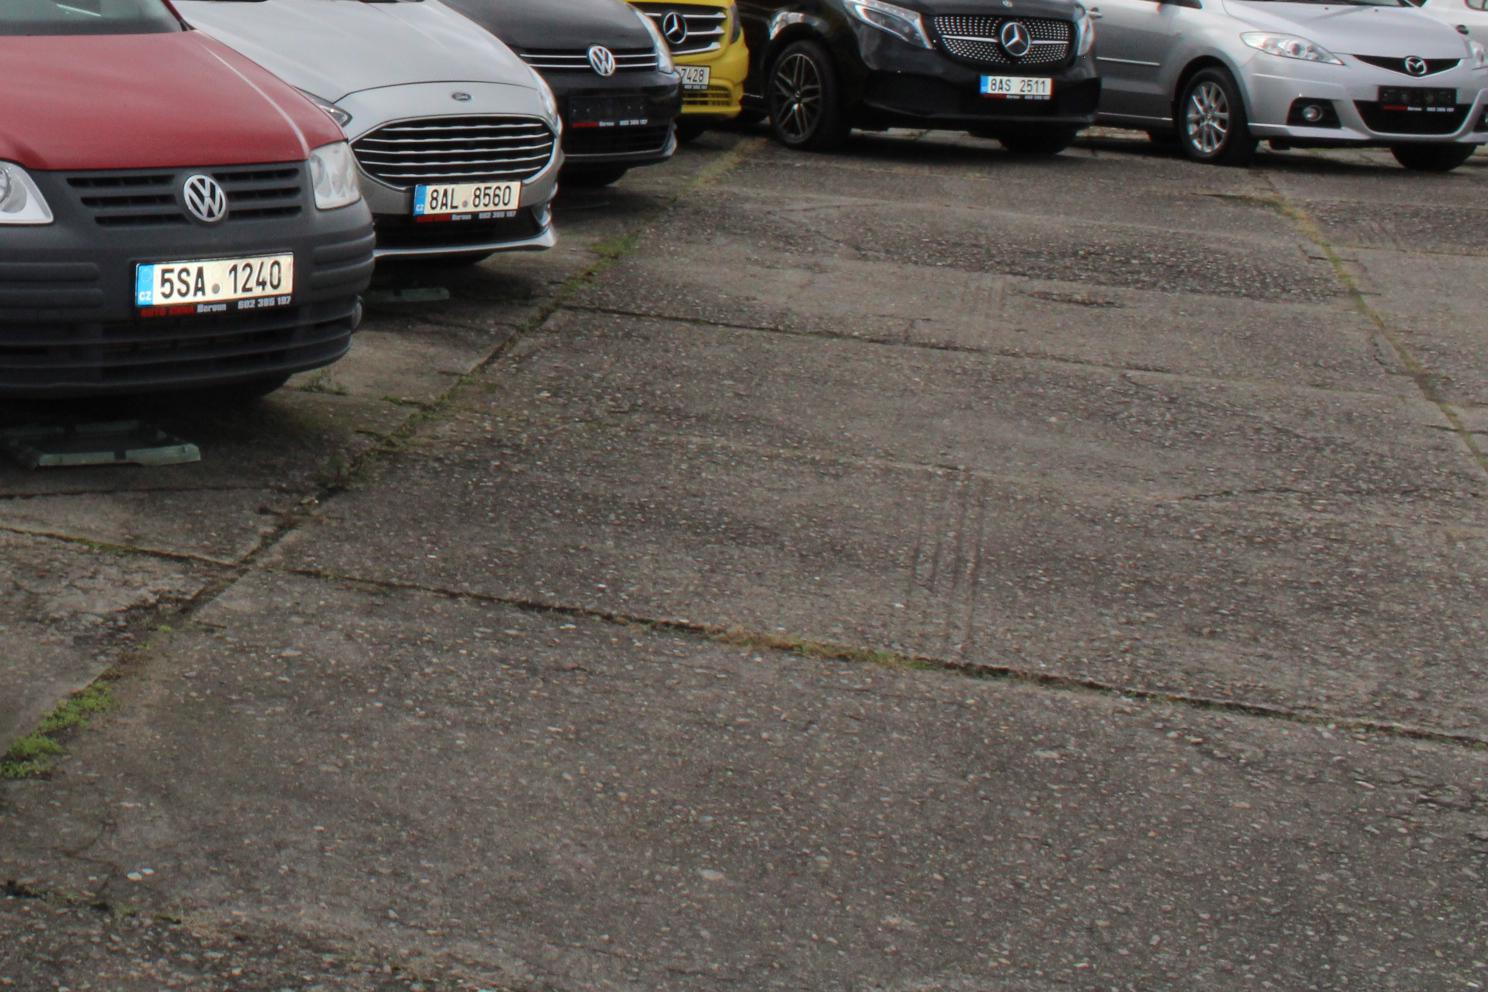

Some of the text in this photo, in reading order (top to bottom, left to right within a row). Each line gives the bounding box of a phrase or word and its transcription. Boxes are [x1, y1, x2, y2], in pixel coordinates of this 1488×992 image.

[990, 78, 1046, 93] 8AS 2511
[429, 188, 459, 210] 8AL
[472, 185, 512, 208] 8560
[139, 260, 282, 301] CZ 5SA 1240
